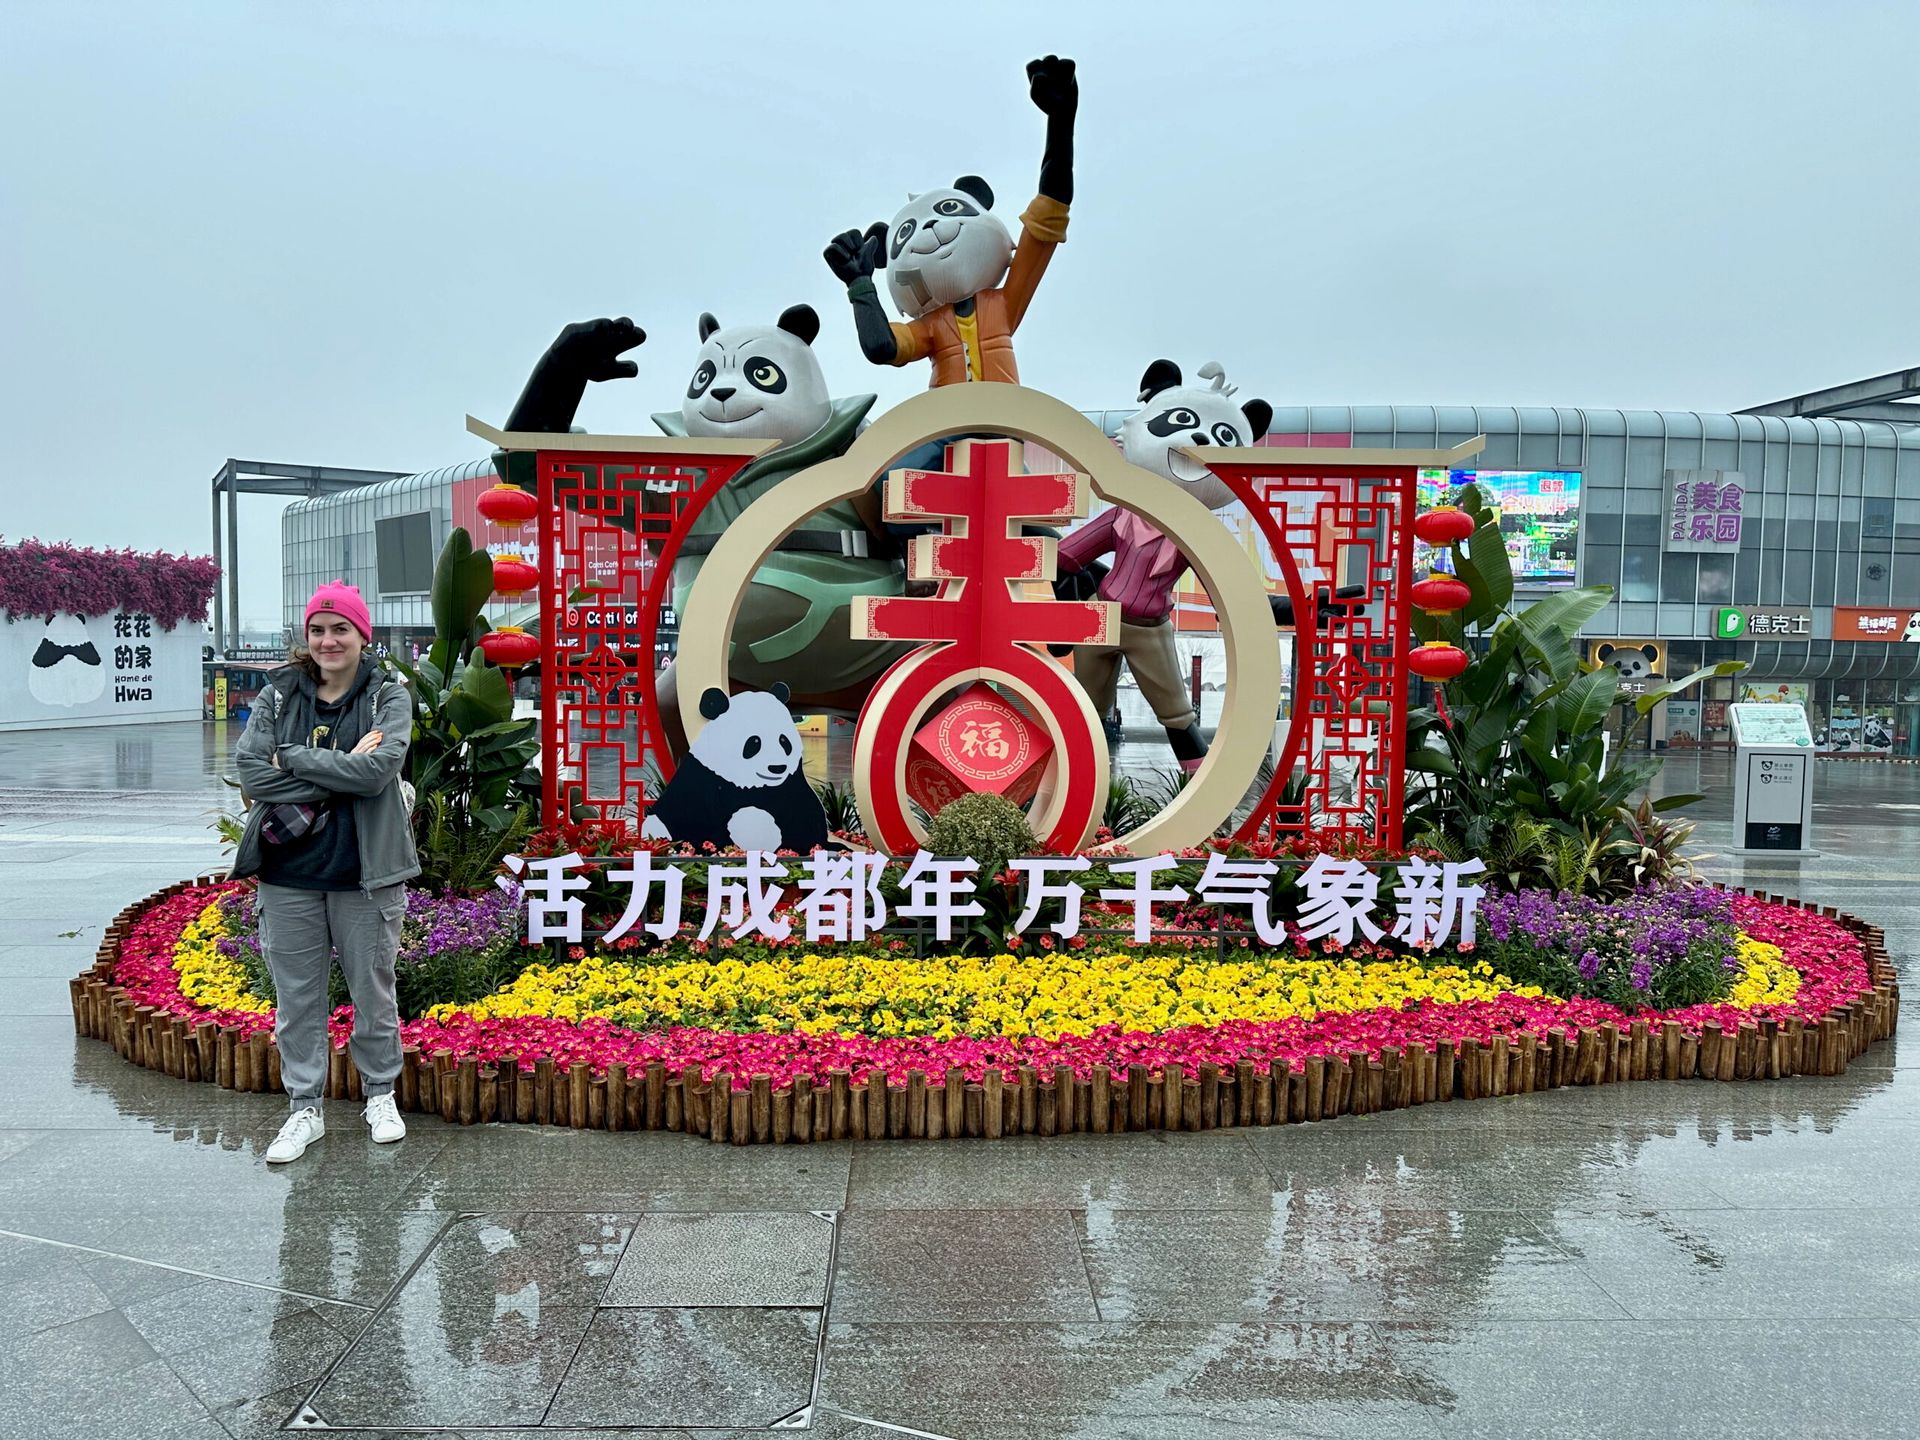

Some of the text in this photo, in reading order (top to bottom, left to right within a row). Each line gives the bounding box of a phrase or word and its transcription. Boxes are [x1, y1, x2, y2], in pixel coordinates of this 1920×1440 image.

[1691, 481, 1745, 512] 美食
[1671, 481, 1689, 541] PANDA
[1688, 512, 1743, 543] 乐园
[113, 612, 151, 638] 花花
[1749, 613, 1811, 635] 德克士
[114, 644, 152, 670] 的家
[114, 674, 153, 684] Home de
[1617, 682, 1646, 693] 克士
[114, 685, 153, 703] Hwa
[959, 720, 1010, 760] 福
